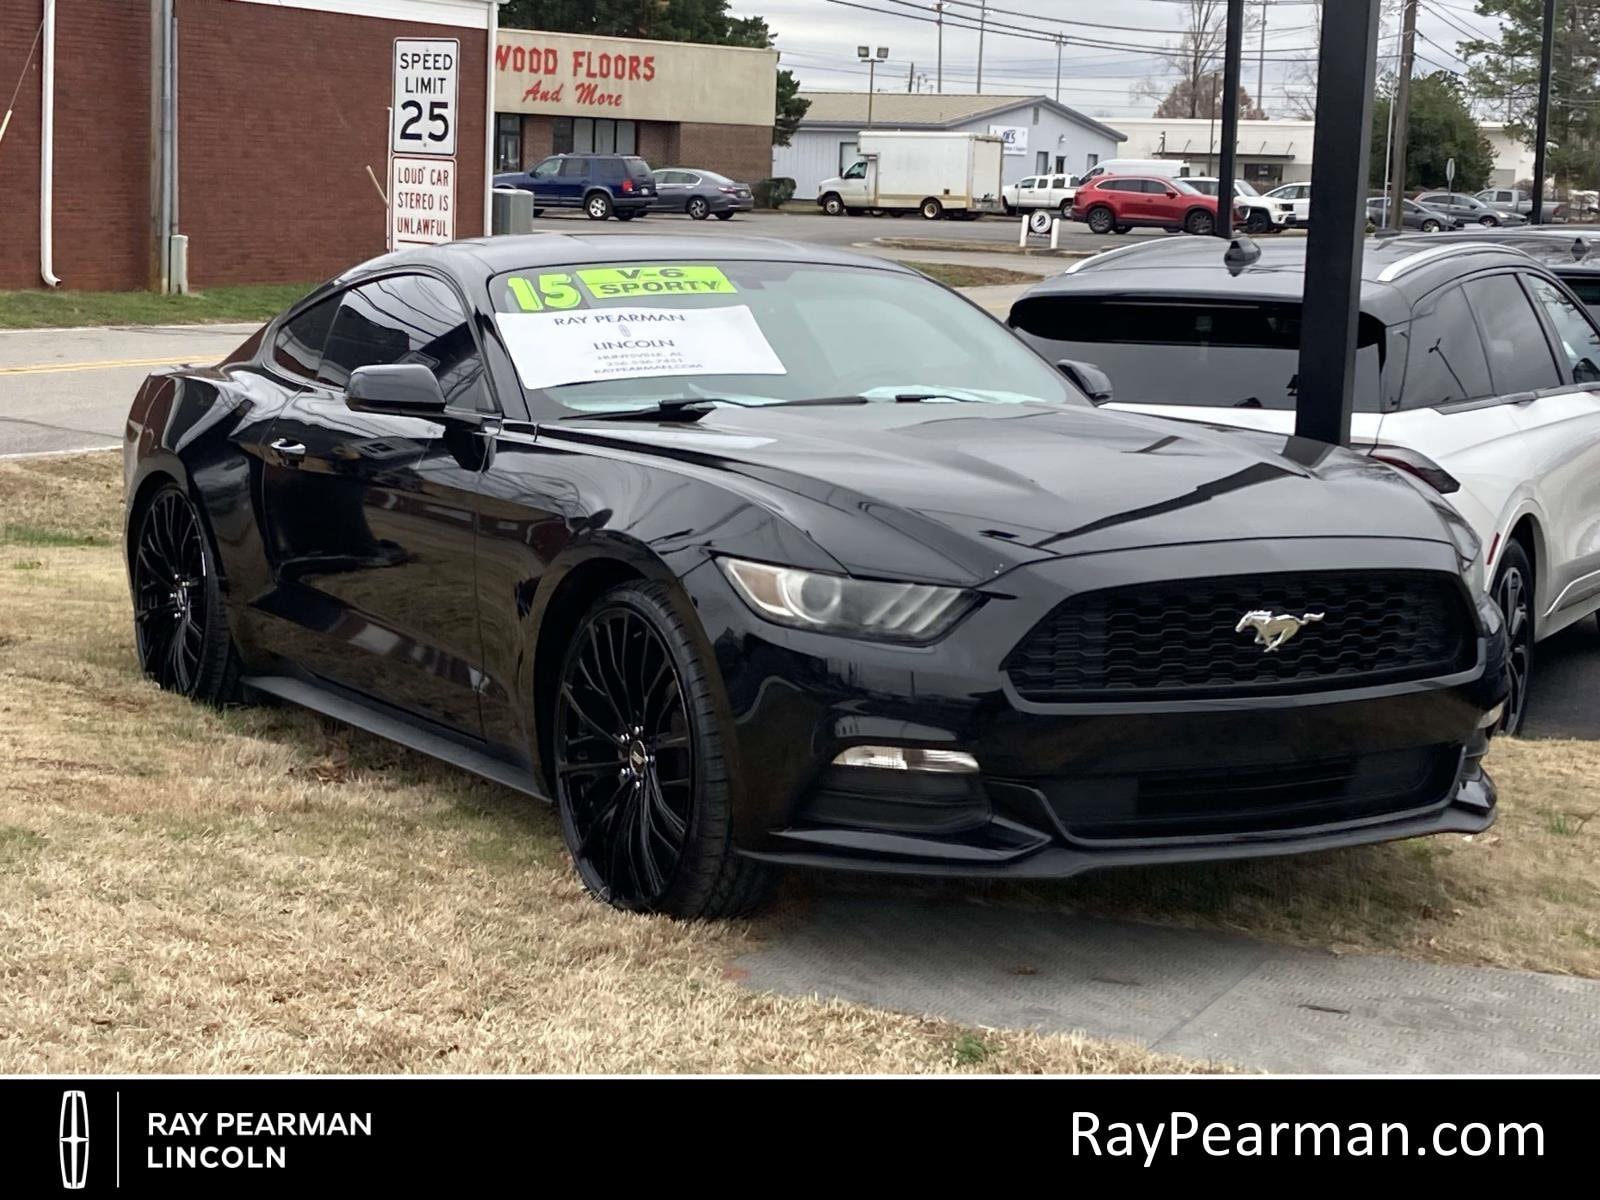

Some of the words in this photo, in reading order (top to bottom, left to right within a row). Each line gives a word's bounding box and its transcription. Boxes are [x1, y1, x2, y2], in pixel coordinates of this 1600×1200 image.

[399, 53, 453, 71] SPEED
[495, 45, 558, 75] WOOD
[572, 51, 655, 82] FLOORS
[405, 77, 446, 95] LIMIT
[522, 80, 563, 103] And
[575, 82, 623, 107] More
[399, 99, 449, 142] 25
[398, 167, 424, 185] LOUD
[430, 168, 449, 187] CAR
[397, 191, 434, 210] STEREO
[439, 194, 449, 211] IS
[397, 216, 448, 237] UNLAWFUL
[616, 268, 685, 280] V-6
[507, 273, 582, 311] 15
[599, 280, 721, 294] SPORTY
[553, 316, 588, 326] RAY
[595, 313, 686, 323] PEARMAN
[593, 339, 675, 350] LINCOLN
